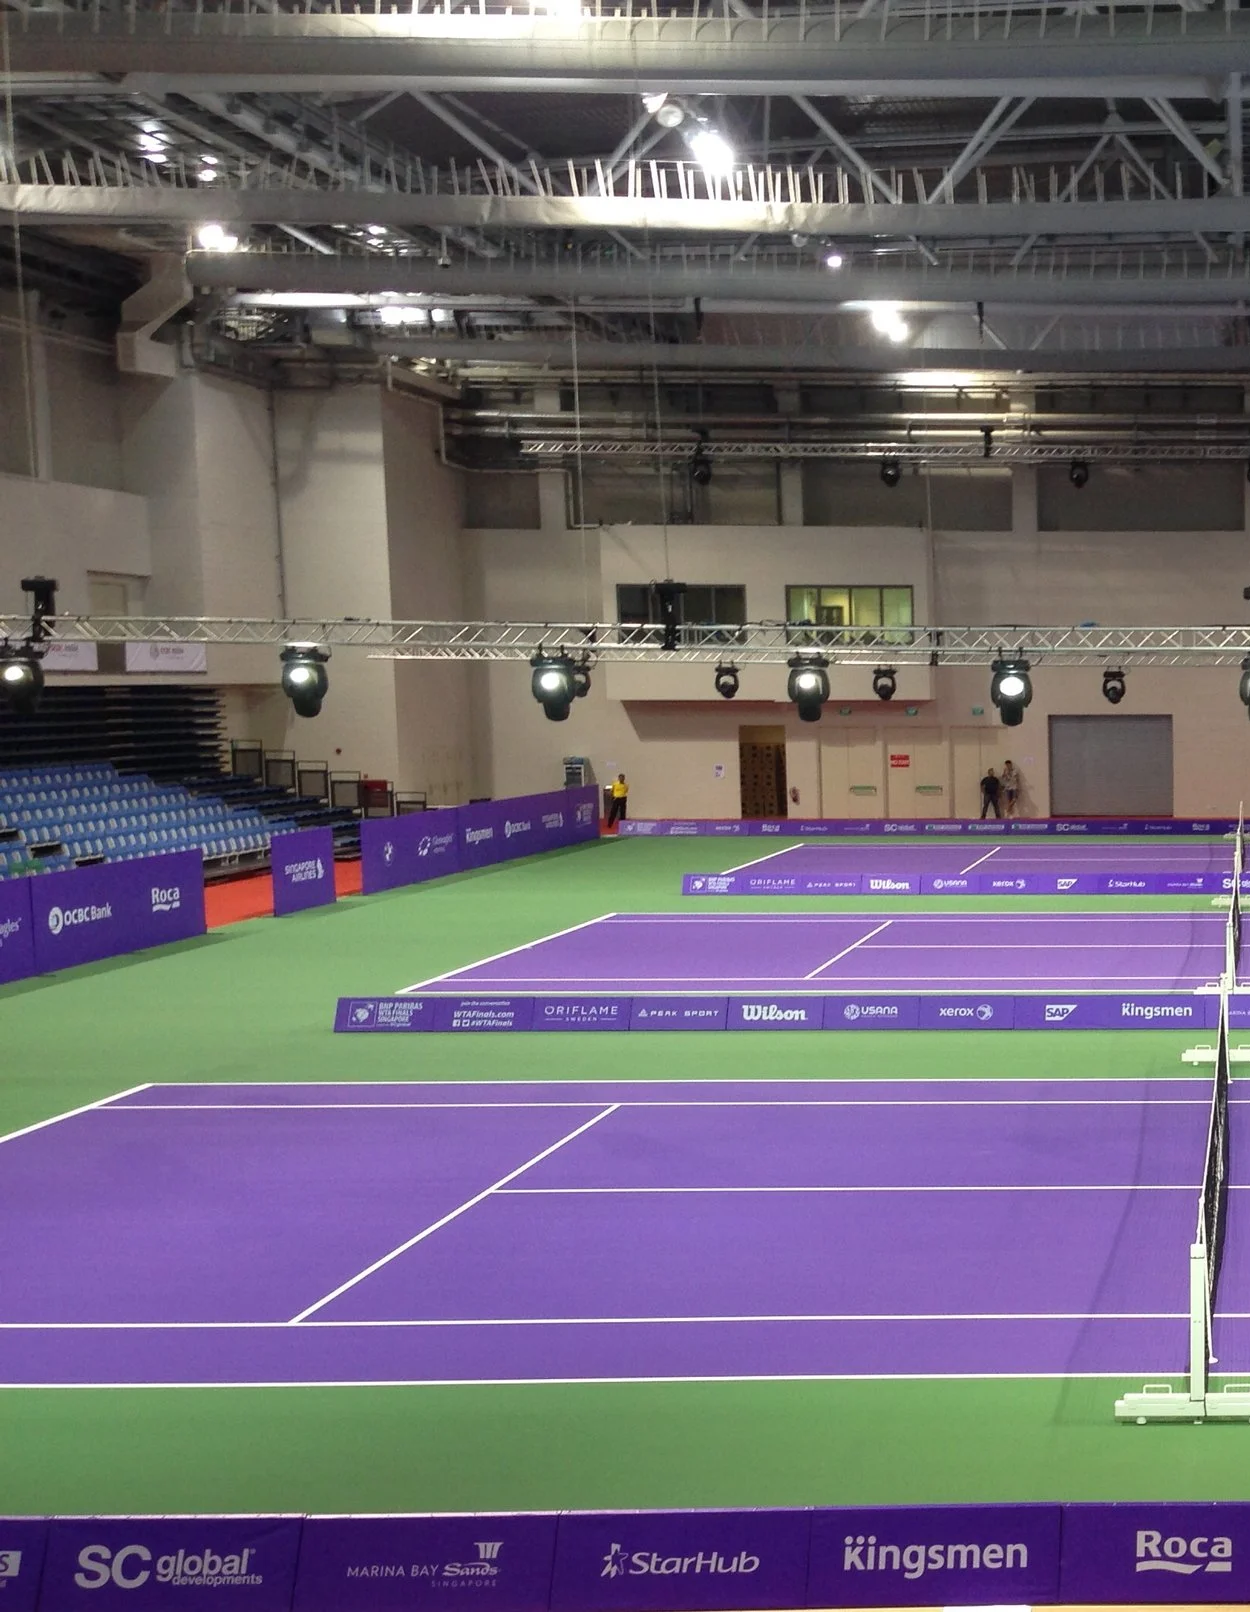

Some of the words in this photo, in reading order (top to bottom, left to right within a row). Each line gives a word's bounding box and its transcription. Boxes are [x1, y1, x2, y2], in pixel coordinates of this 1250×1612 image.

[870, 879, 910, 889] Wilson
[151, 887, 180, 904] Roca
[64, 908, 90, 926] OCBC
[91, 902, 112, 920] Bank
[379, 1002, 394, 1010] BNP
[395, 1002, 423, 1010] PARIBAS
[454, 1010, 515, 1018] WTAFinals.com
[544, 1006, 618, 1015] ORIFLAME
[742, 1005, 807, 1021] Wilson
[861, 1006, 898, 1014] USANA
[939, 1007, 974, 1016] xerox
[1047, 1007, 1069, 1017] SAP
[1122, 1003, 1193, 1019] Kingsmen
[1136, 1531, 1233, 1560] Roca
[629, 1551, 760, 1576] StarHub
[843, 1536, 1029, 1579] Kingsmen
[74, 1544, 151, 1589] SC
[156, 1547, 250, 1587] global
[347, 1565, 403, 1577] MARINA
[404, 1565, 440, 1577] BAY
[443, 1561, 500, 1577] Sands
[171, 1572, 263, 1588] developments
[431, 1580, 498, 1588] SINGAPORE
